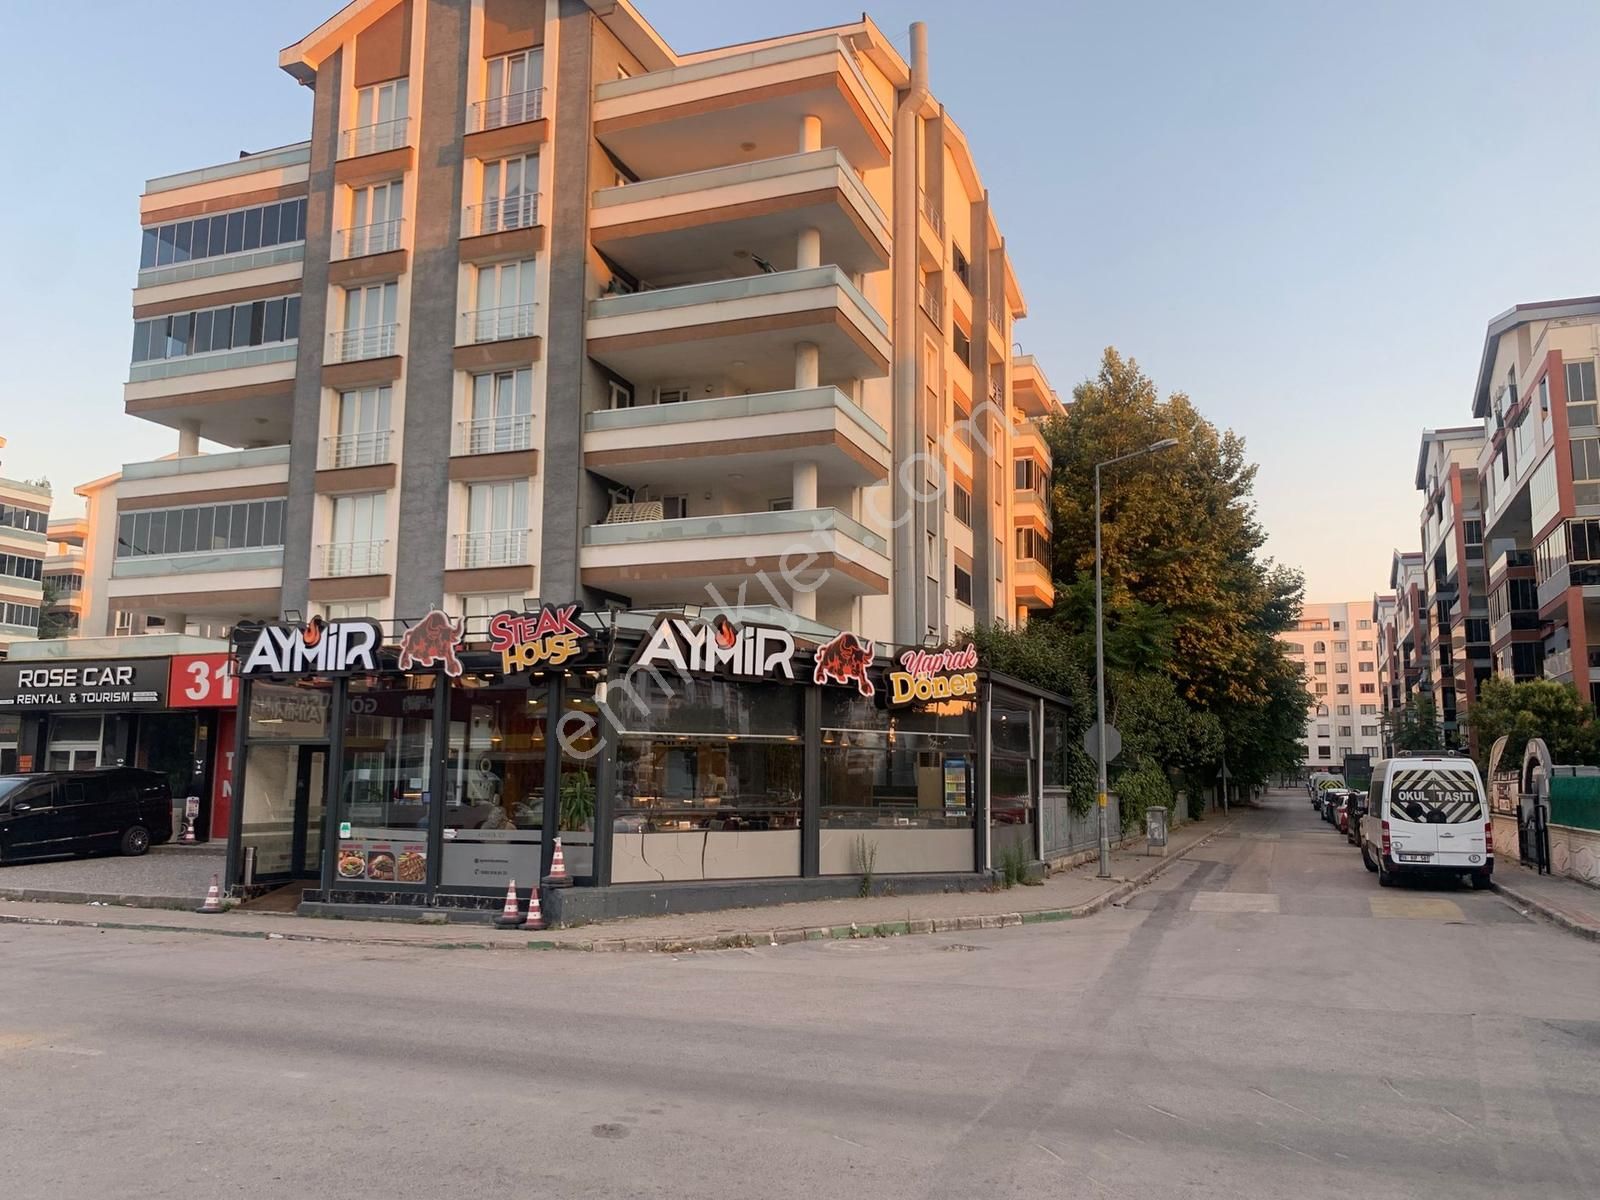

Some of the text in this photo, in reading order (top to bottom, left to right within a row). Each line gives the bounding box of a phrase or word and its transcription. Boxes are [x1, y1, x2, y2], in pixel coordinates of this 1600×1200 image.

[490, 604, 588, 652] STEAK
[501, 632, 580, 675] HOUSE
[900, 643, 978, 679] Yaprak
[18, 666, 133, 688] ROSE CAR
[890, 671, 978, 704] Döner
[16, 693, 62, 705] RENTAL
[69, 692, 77, 704] &
[81, 691, 130, 704] TOURISM
[1398, 791, 1474, 803] OKUL TAŞITI
